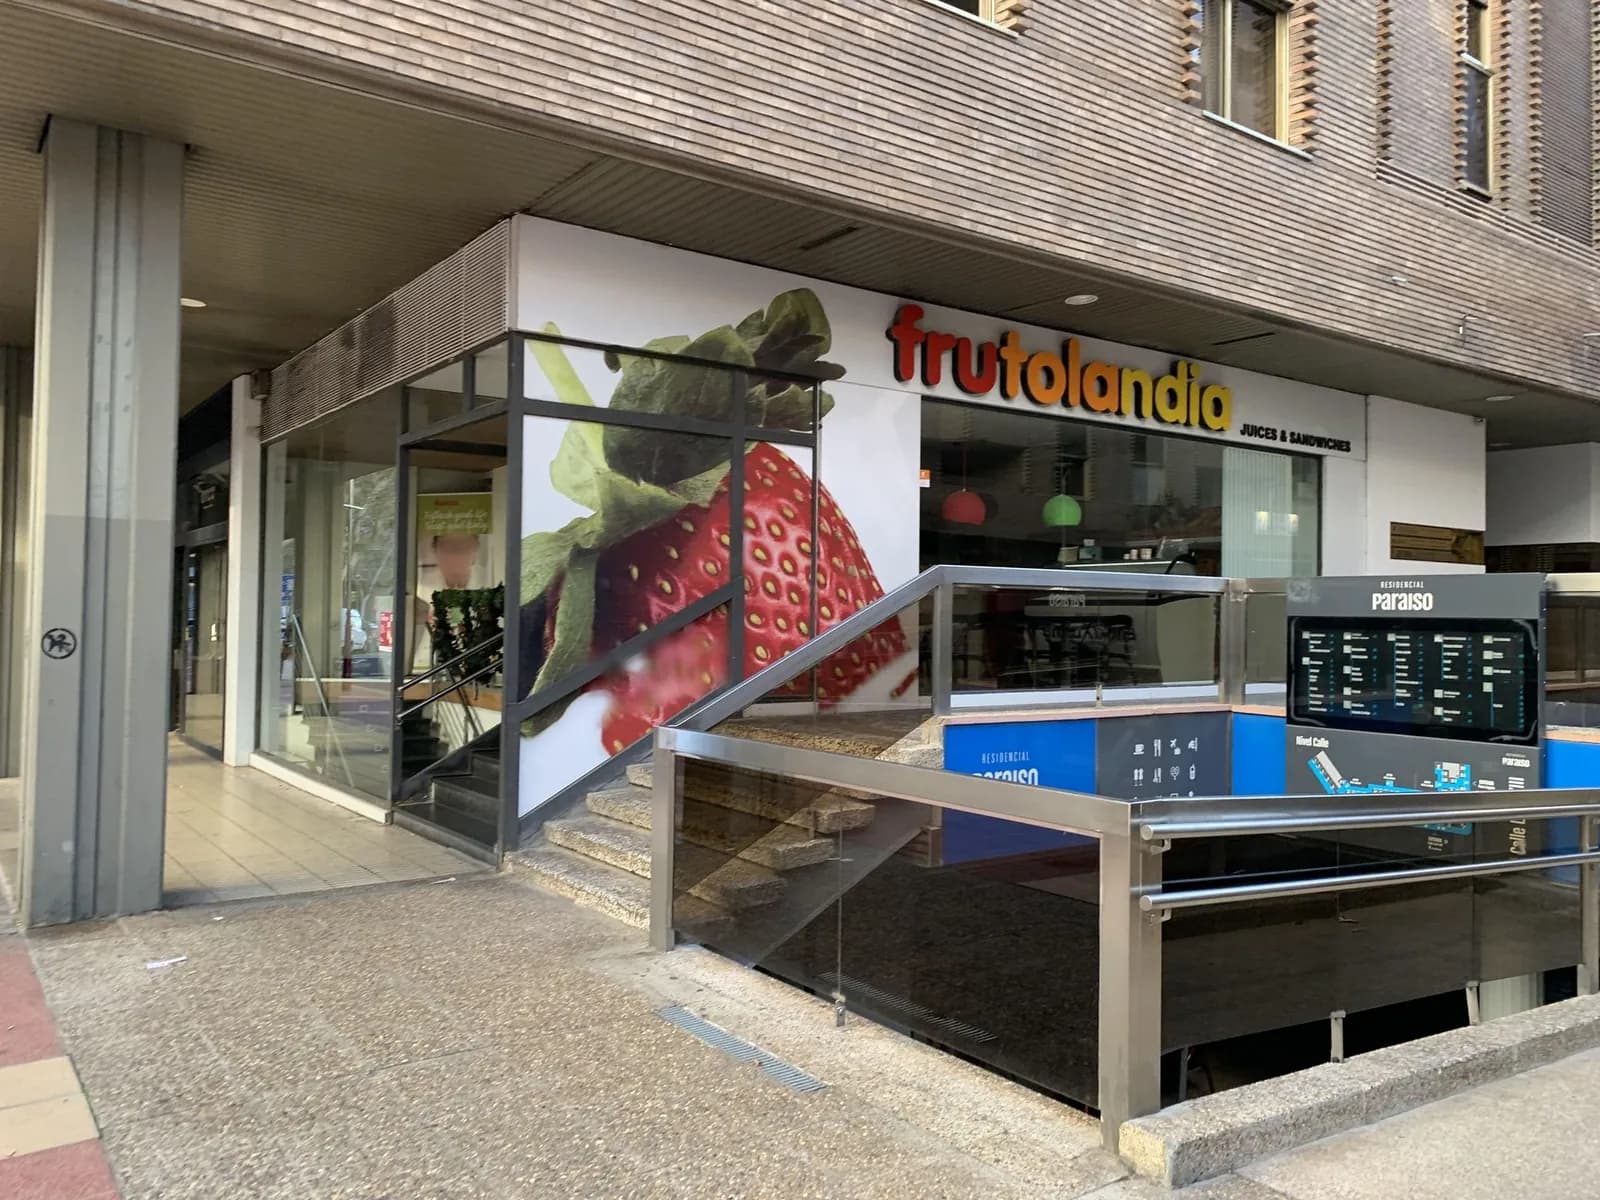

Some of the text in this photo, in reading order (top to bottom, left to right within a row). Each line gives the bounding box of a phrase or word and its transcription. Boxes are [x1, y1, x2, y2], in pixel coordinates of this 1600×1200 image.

[888, 303, 1232, 433] frutolandia
[1240, 423, 1351, 453] JUICES & SANDWICHES
[1380, 580, 1424, 589] RESIDENCIAL
[981, 751, 1030, 764] RESIDENCIAL
[1509, 827, 1526, 856] Calle
